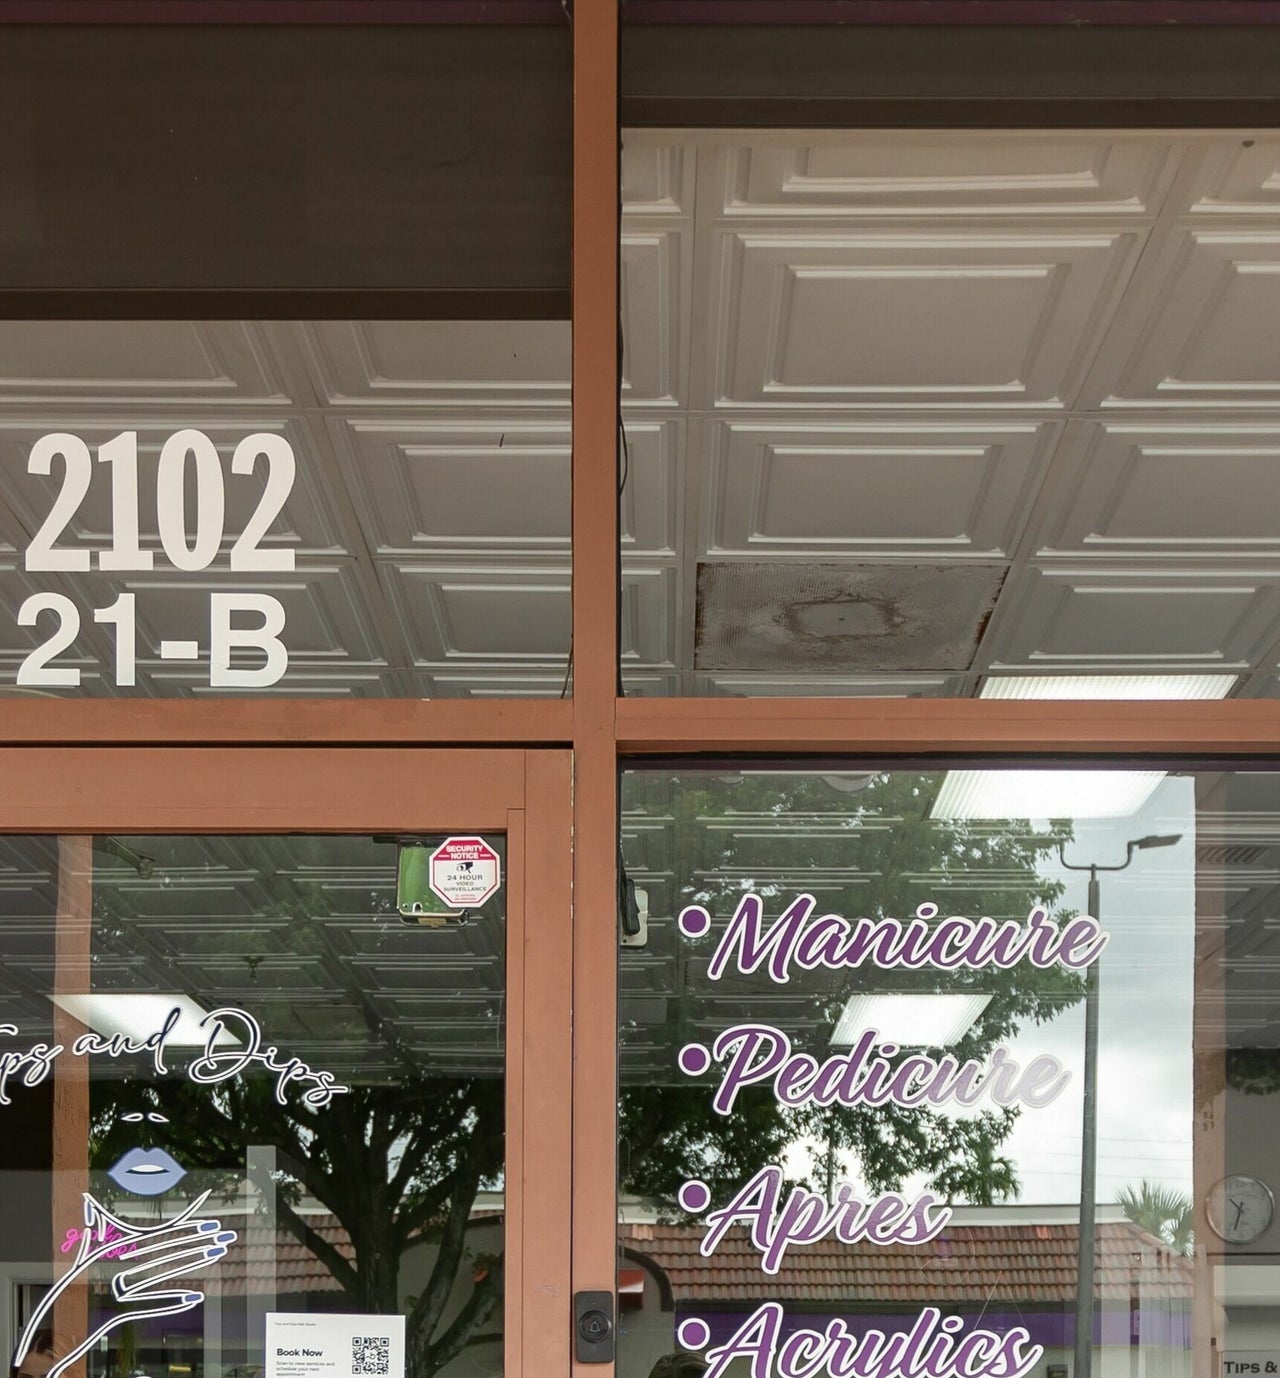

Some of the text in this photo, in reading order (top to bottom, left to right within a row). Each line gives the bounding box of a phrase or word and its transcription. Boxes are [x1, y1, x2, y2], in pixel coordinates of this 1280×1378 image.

[25, 428, 296, 572] 2102
[16, 592, 289, 687] 21-B
[708, 893, 1111, 984] Manicure
[72, 1006, 181, 1075] and
[188, 1008, 349, 1107] Dips
[712, 1024, 1072, 1116] Pedicure
[699, 1165, 953, 1275] Apres
[276, 1348, 324, 1356] Book Now
[1223, 1361, 1261, 1374] TIPS
[1264, 1360, 1278, 1374] &
